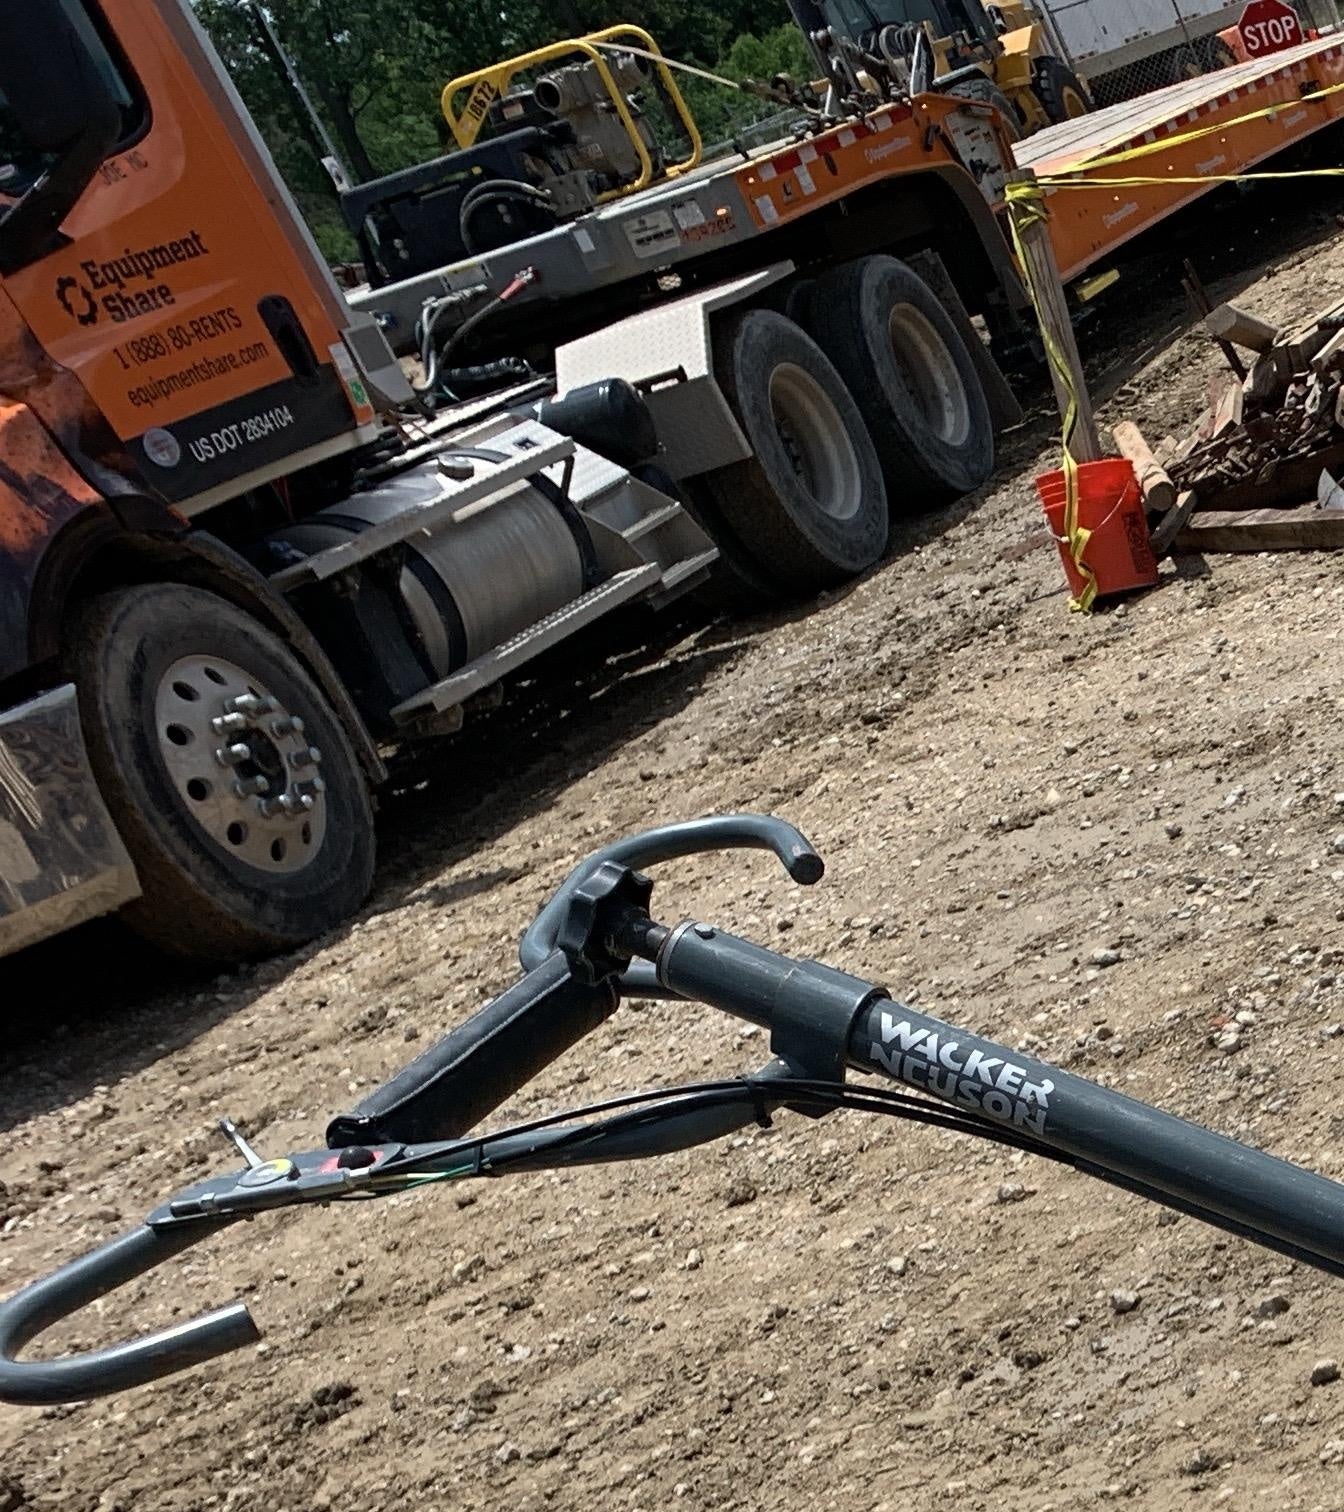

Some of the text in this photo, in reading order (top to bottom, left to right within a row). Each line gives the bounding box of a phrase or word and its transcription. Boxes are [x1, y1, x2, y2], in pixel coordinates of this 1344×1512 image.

[1244, 15, 1295, 50] STOP
[467, 80, 495, 121] 18672
[80, 229, 209, 289] Equipment
[101, 282, 176, 323] Share
[113, 306, 243, 370] 1 (888) 80-RENTS
[127, 340, 269, 408] equipmentshare.com
[188, 437, 215, 463] US
[213, 424, 244, 454] DOT
[241, 405, 294, 440] 2834104
[870, 1041, 1046, 1136] NEUSON
[880, 1011, 1055, 1109] WACKER
